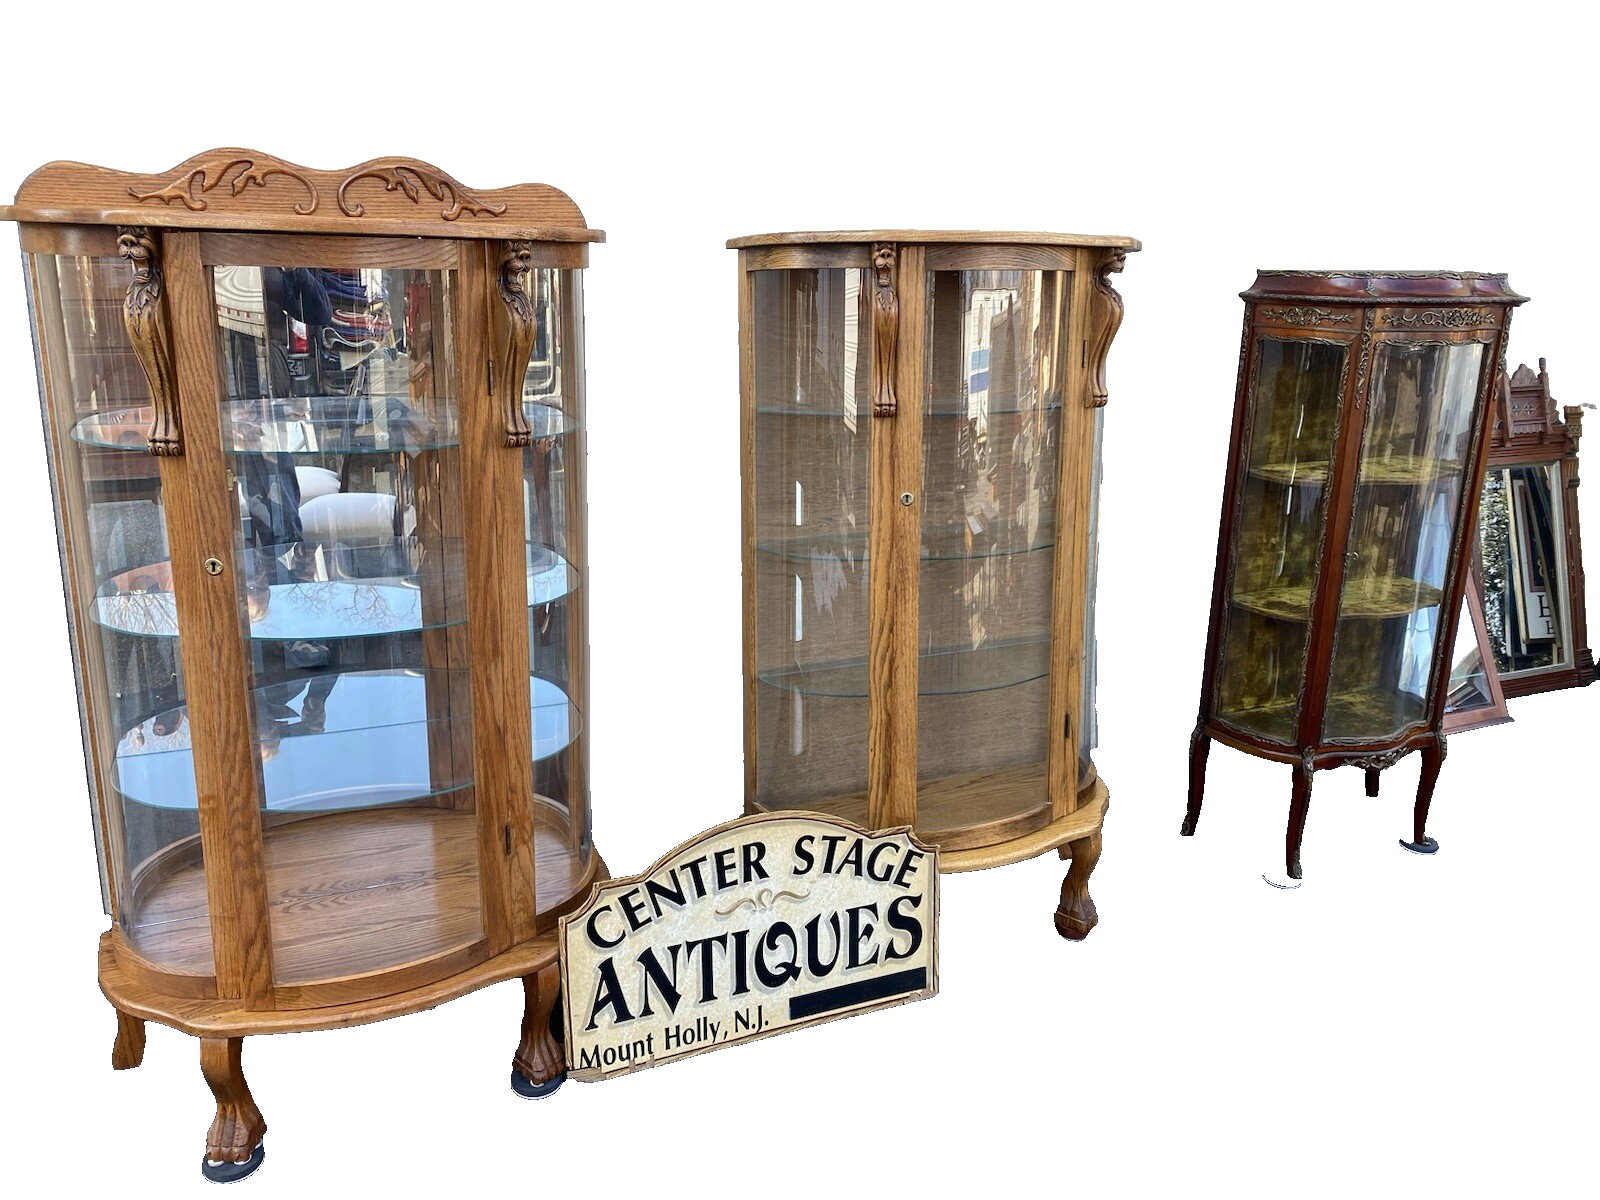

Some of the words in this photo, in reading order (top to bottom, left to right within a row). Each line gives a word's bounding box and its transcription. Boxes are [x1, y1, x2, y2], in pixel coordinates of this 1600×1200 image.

[586, 841, 769, 949] CENTER
[792, 835, 925, 889] STAGE
[584, 893, 924, 1031] ANTIQUES
[579, 1032, 655, 1069] Mount
[664, 1016, 729, 1051] Holly,
[734, 1005, 769, 1034] N.J.
